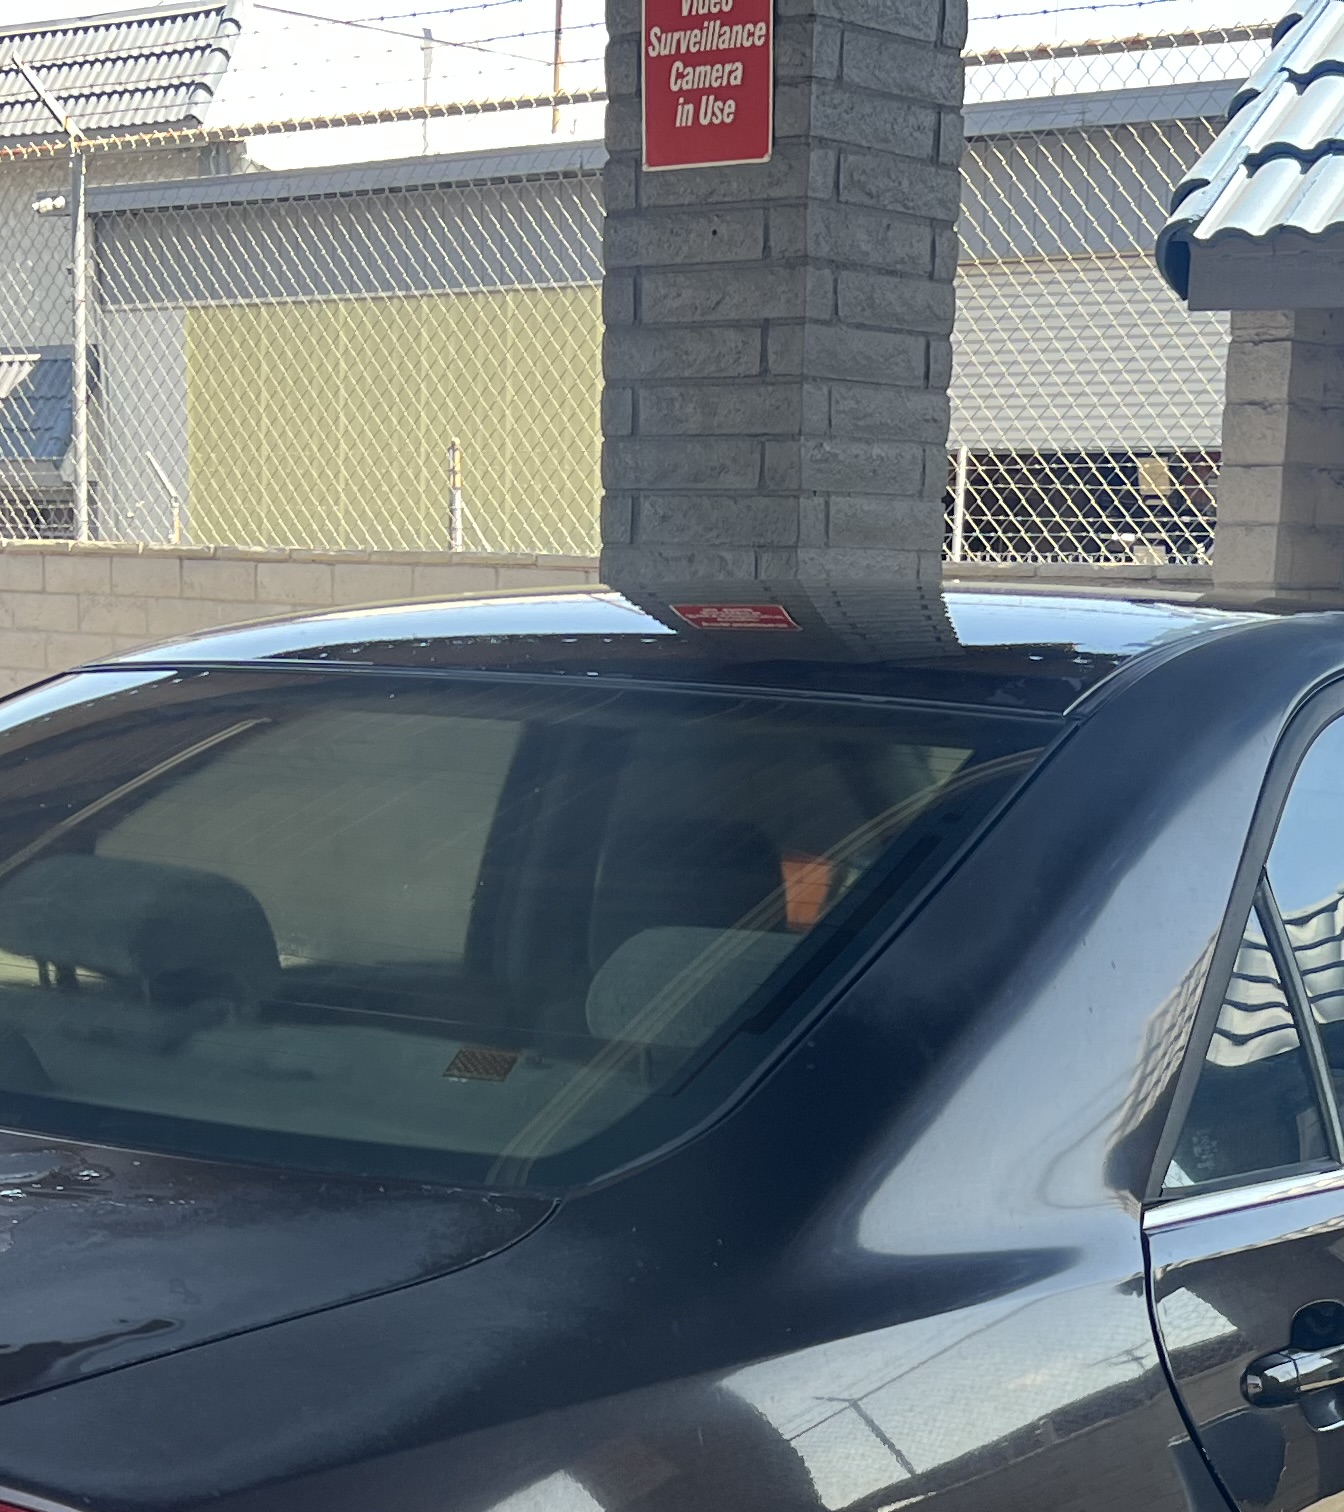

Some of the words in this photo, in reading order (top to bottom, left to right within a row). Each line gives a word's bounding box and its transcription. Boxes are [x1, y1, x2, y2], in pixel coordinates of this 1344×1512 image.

[648, 20, 767, 57] Surveillance
[669, 60, 744, 92] Camera
[675, 96, 694, 128] in
[698, 94, 736, 126] Use
